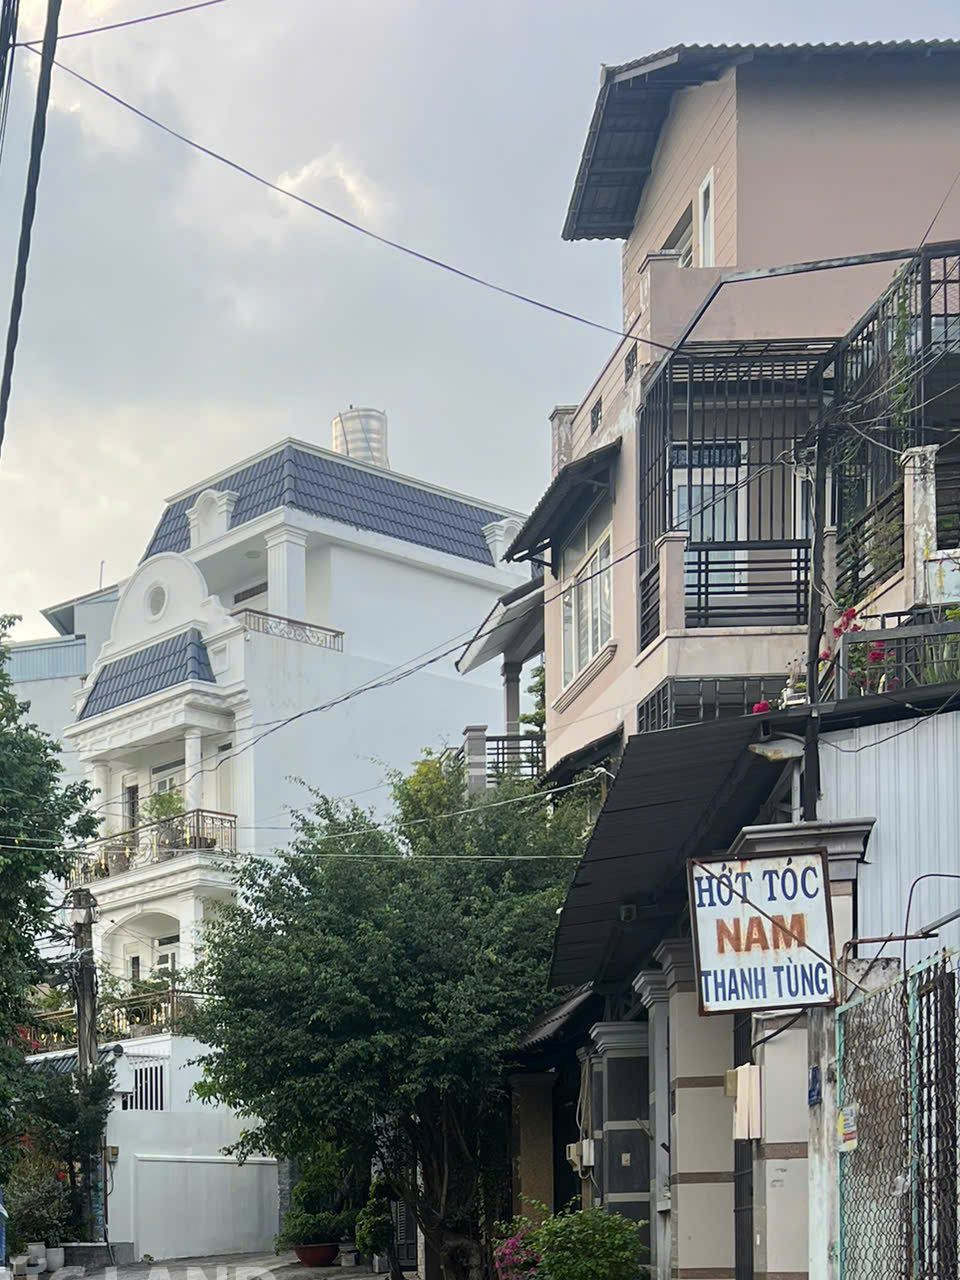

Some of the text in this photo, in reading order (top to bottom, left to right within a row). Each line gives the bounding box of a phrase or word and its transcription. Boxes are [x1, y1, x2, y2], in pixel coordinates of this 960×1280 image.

[695, 857, 819, 907] HỚT TÓC
[716, 913, 806, 954] NAM
[701, 957, 828, 1002] THANH TÙNG
